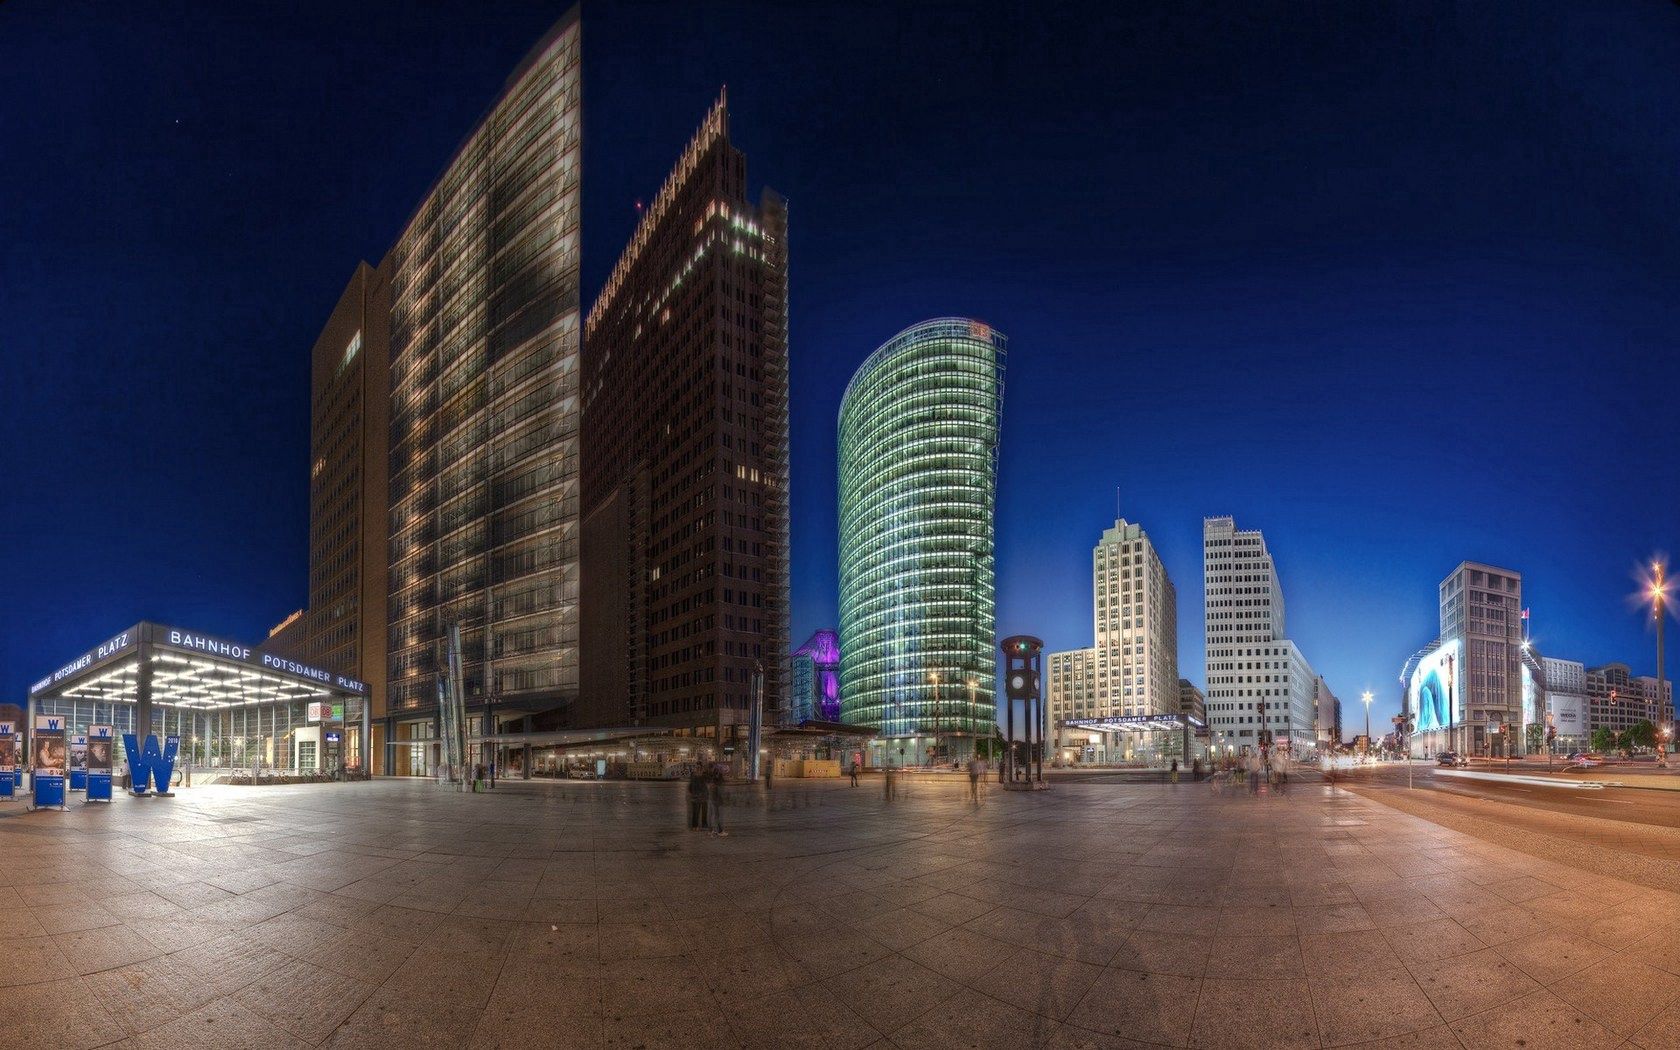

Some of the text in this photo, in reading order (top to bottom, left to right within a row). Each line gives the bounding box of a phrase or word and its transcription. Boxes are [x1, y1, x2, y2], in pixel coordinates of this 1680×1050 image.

[54, 654, 91, 681] POTSDAMER
[98, 633, 128, 659] PLATZ
[171, 631, 363, 692] BAHNHOF POTSDAMER PLATZ
[0, 725, 10, 734] W
[48, 719, 59, 730] W
[98, 728, 108, 737] W
[78, 737, 86, 745] W
[122, 734, 180, 793] W
